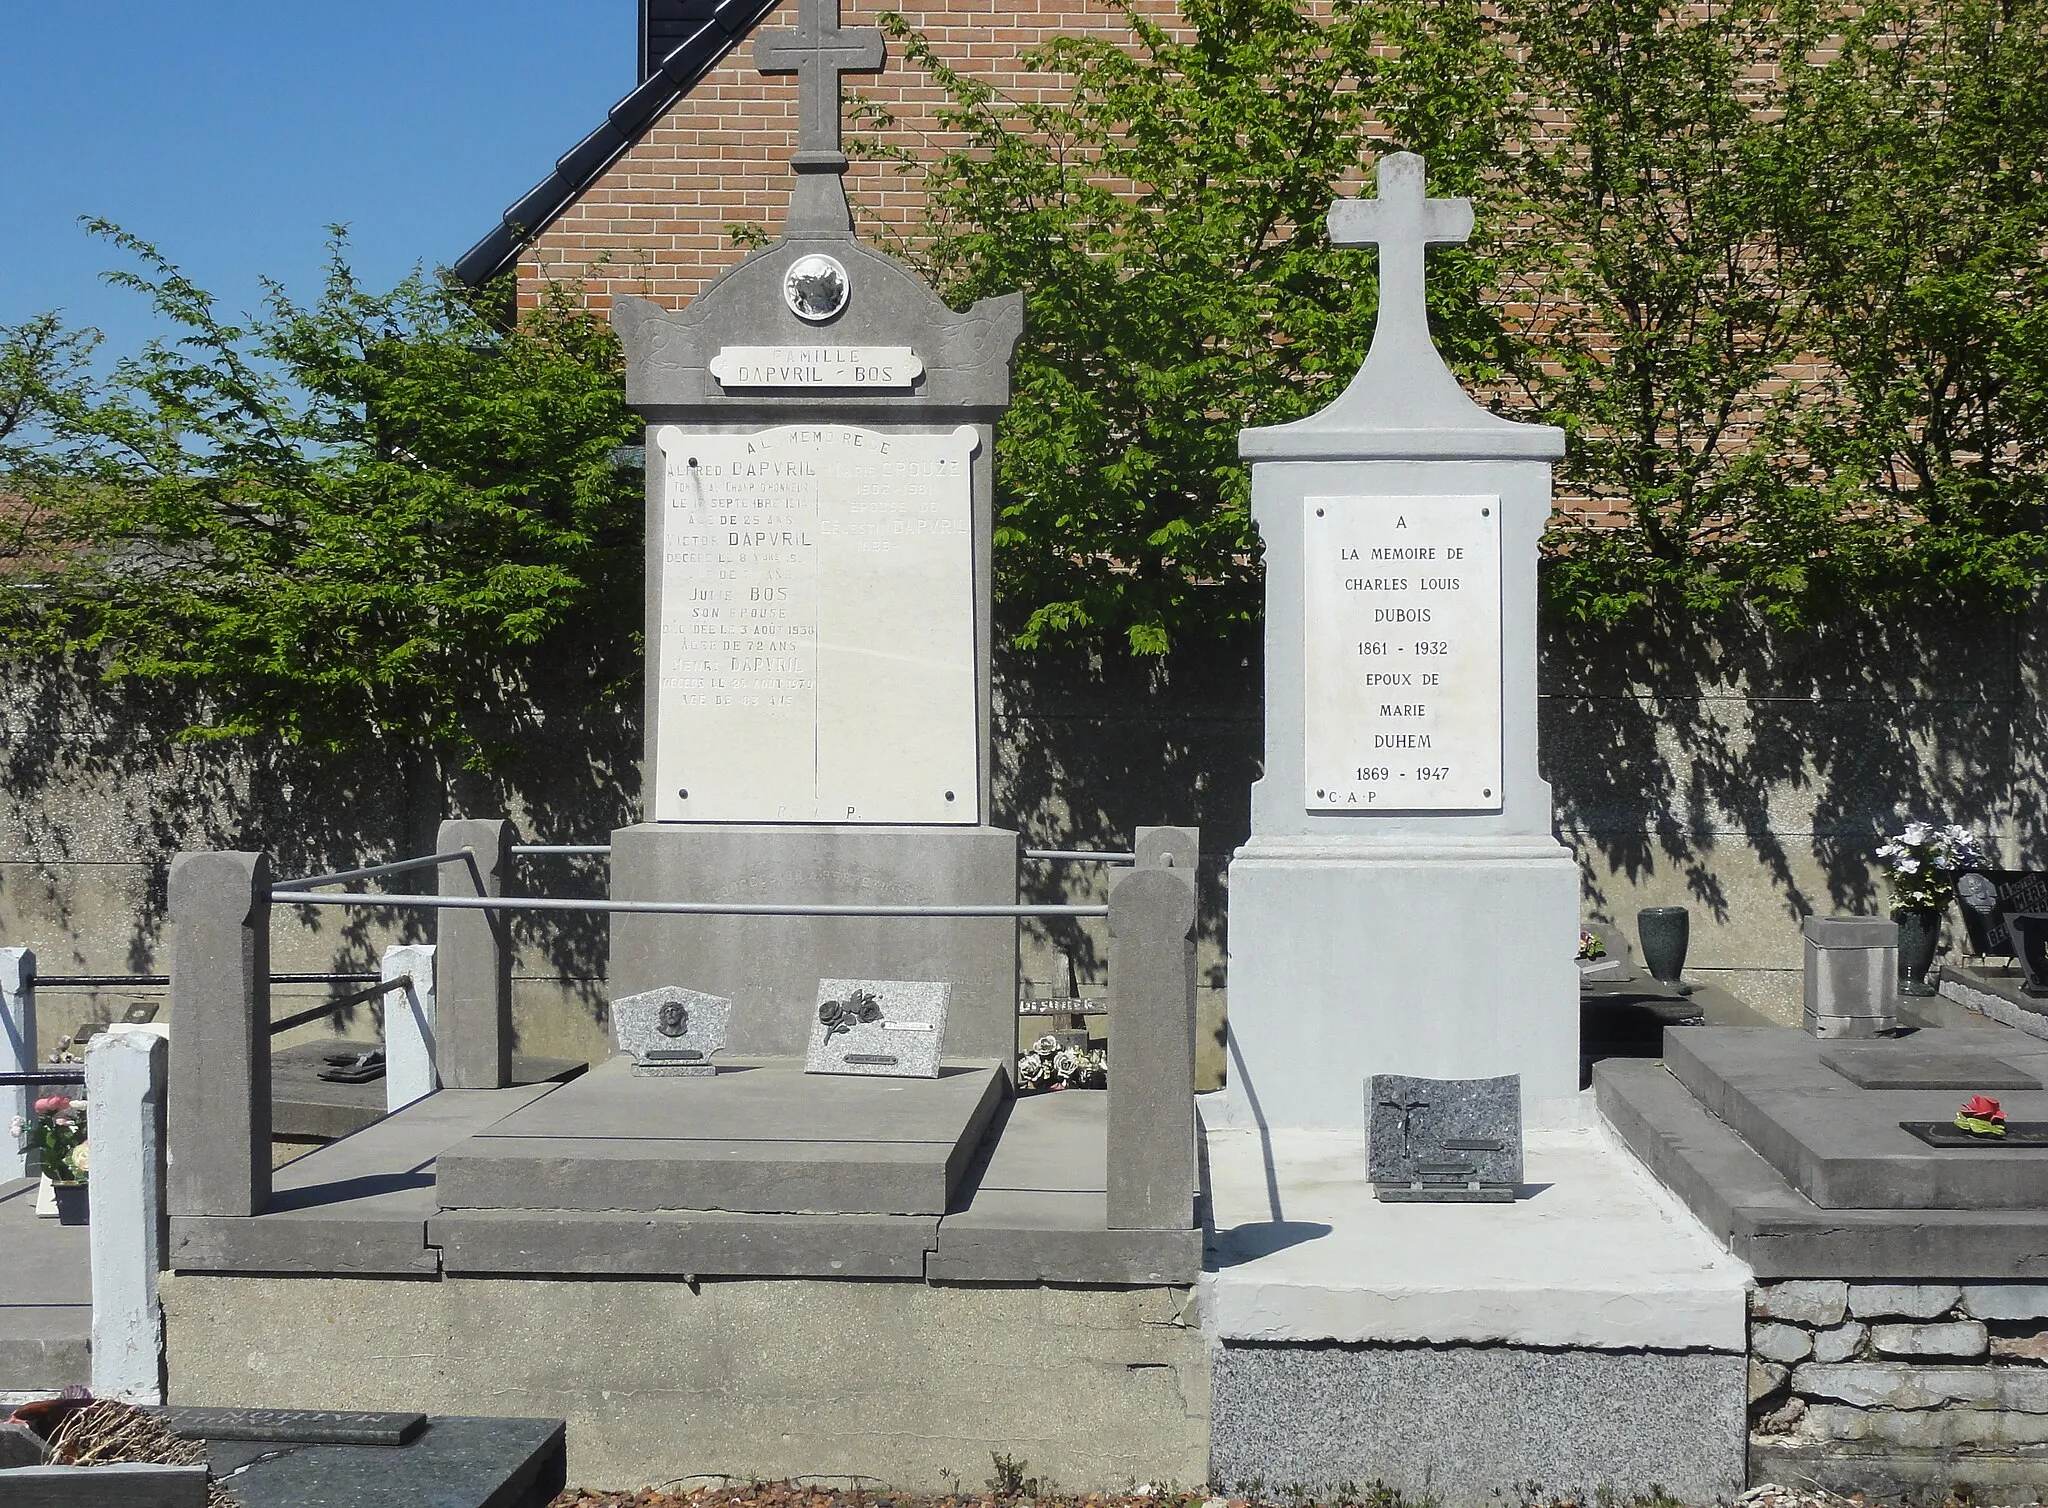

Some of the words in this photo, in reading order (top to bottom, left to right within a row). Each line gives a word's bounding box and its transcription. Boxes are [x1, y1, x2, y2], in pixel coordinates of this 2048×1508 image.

[773, 349, 860, 363] FAMILLE
[854, 366, 893, 382] BOS
[672, 498, 687, 508] LE
[720, 515, 737, 525] DE
[743, 515, 760, 525] 25
[1395, 515, 1407, 530] A
[1341, 547, 1360, 561] LA
[1370, 547, 1436, 561] MEMOIRE
[1446, 547, 1465, 561] DE
[1344, 578, 1409, 592] CHARLES
[1420, 578, 1461, 592] LOUIS
[750, 586, 788, 602] BOS
[691, 607, 720, 619] SON
[1373, 608, 1432, 623] DUBOIS
[723, 640, 742, 651] DE
[746, 640, 764, 651] 72
[769, 640, 797, 651] ANS
[1357, 641, 1388, 656] 1861
[1414, 641, 1449, 656] 1932
[1365, 673, 1413, 687] EPOUX
[1422, 673, 1440, 687] DE
[1379, 704, 1426, 717] MARIE
[1373, 734, 1432, 749] DUHEM
[1356, 767, 1389, 782] 1869
[1416, 767, 1450, 782] 1947
